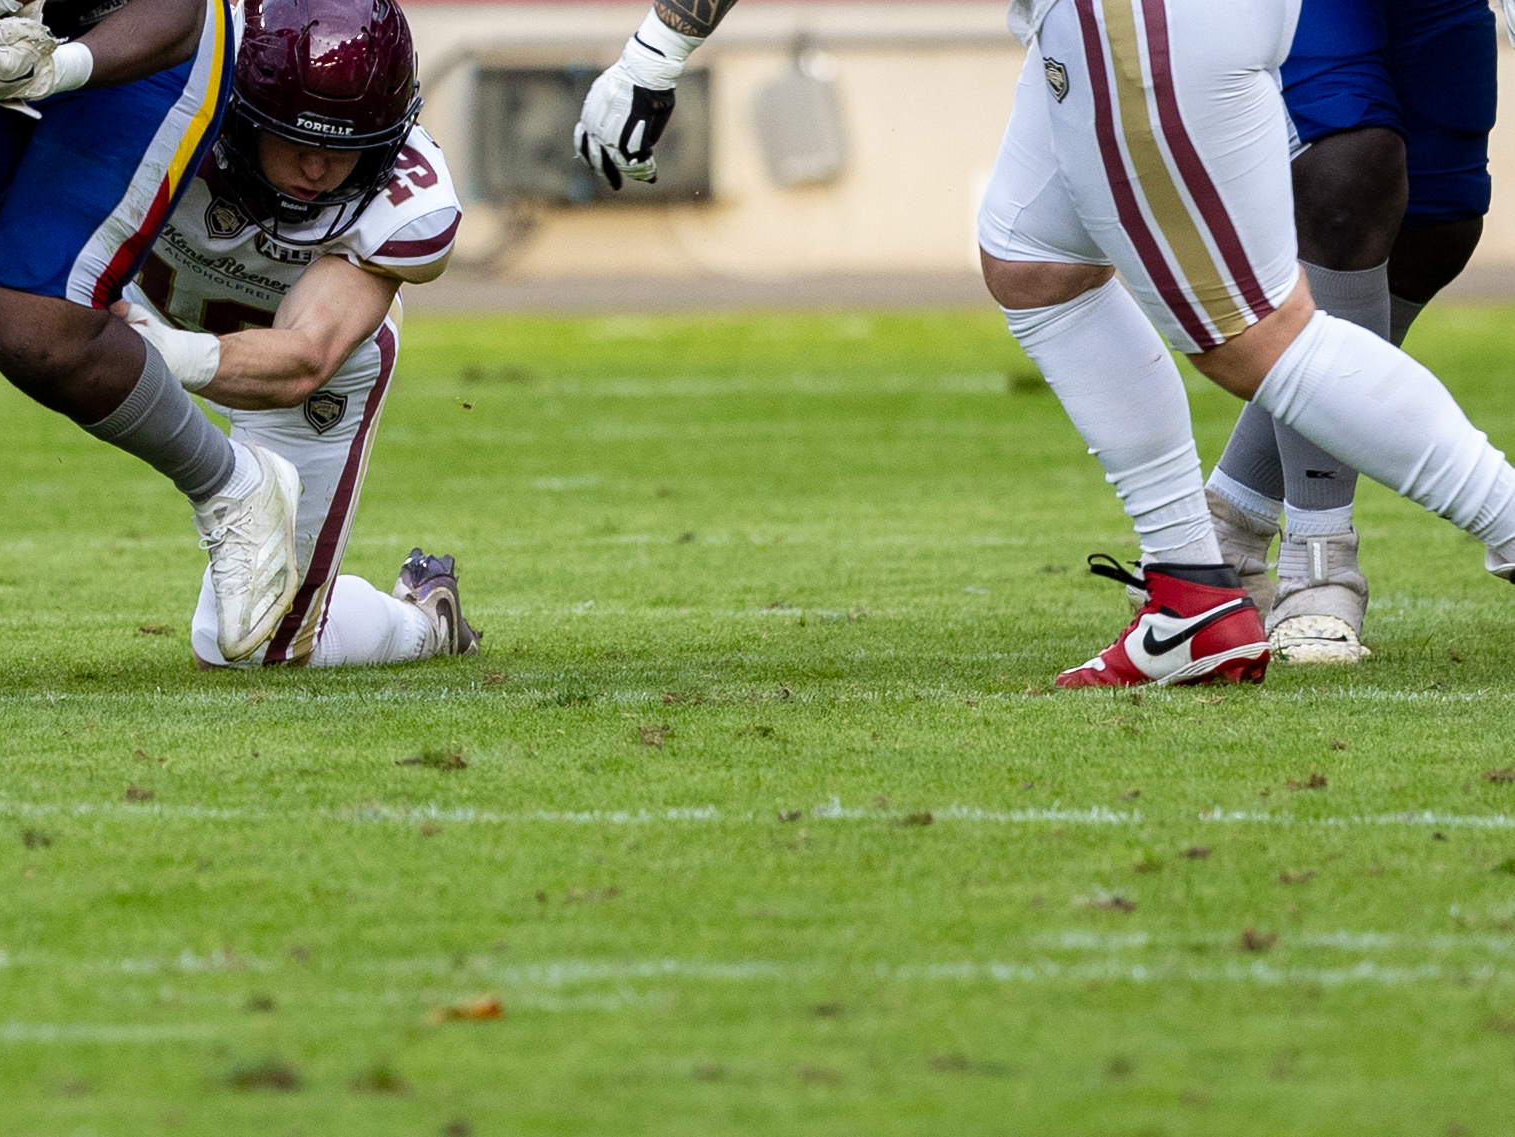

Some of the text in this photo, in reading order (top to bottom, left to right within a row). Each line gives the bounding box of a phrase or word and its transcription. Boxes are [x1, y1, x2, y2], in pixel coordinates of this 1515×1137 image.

[295, 117, 354, 137] FORELLE
[261, 239, 313, 263] AFLE
[164, 245, 271, 301] ALKOHOLFREI
